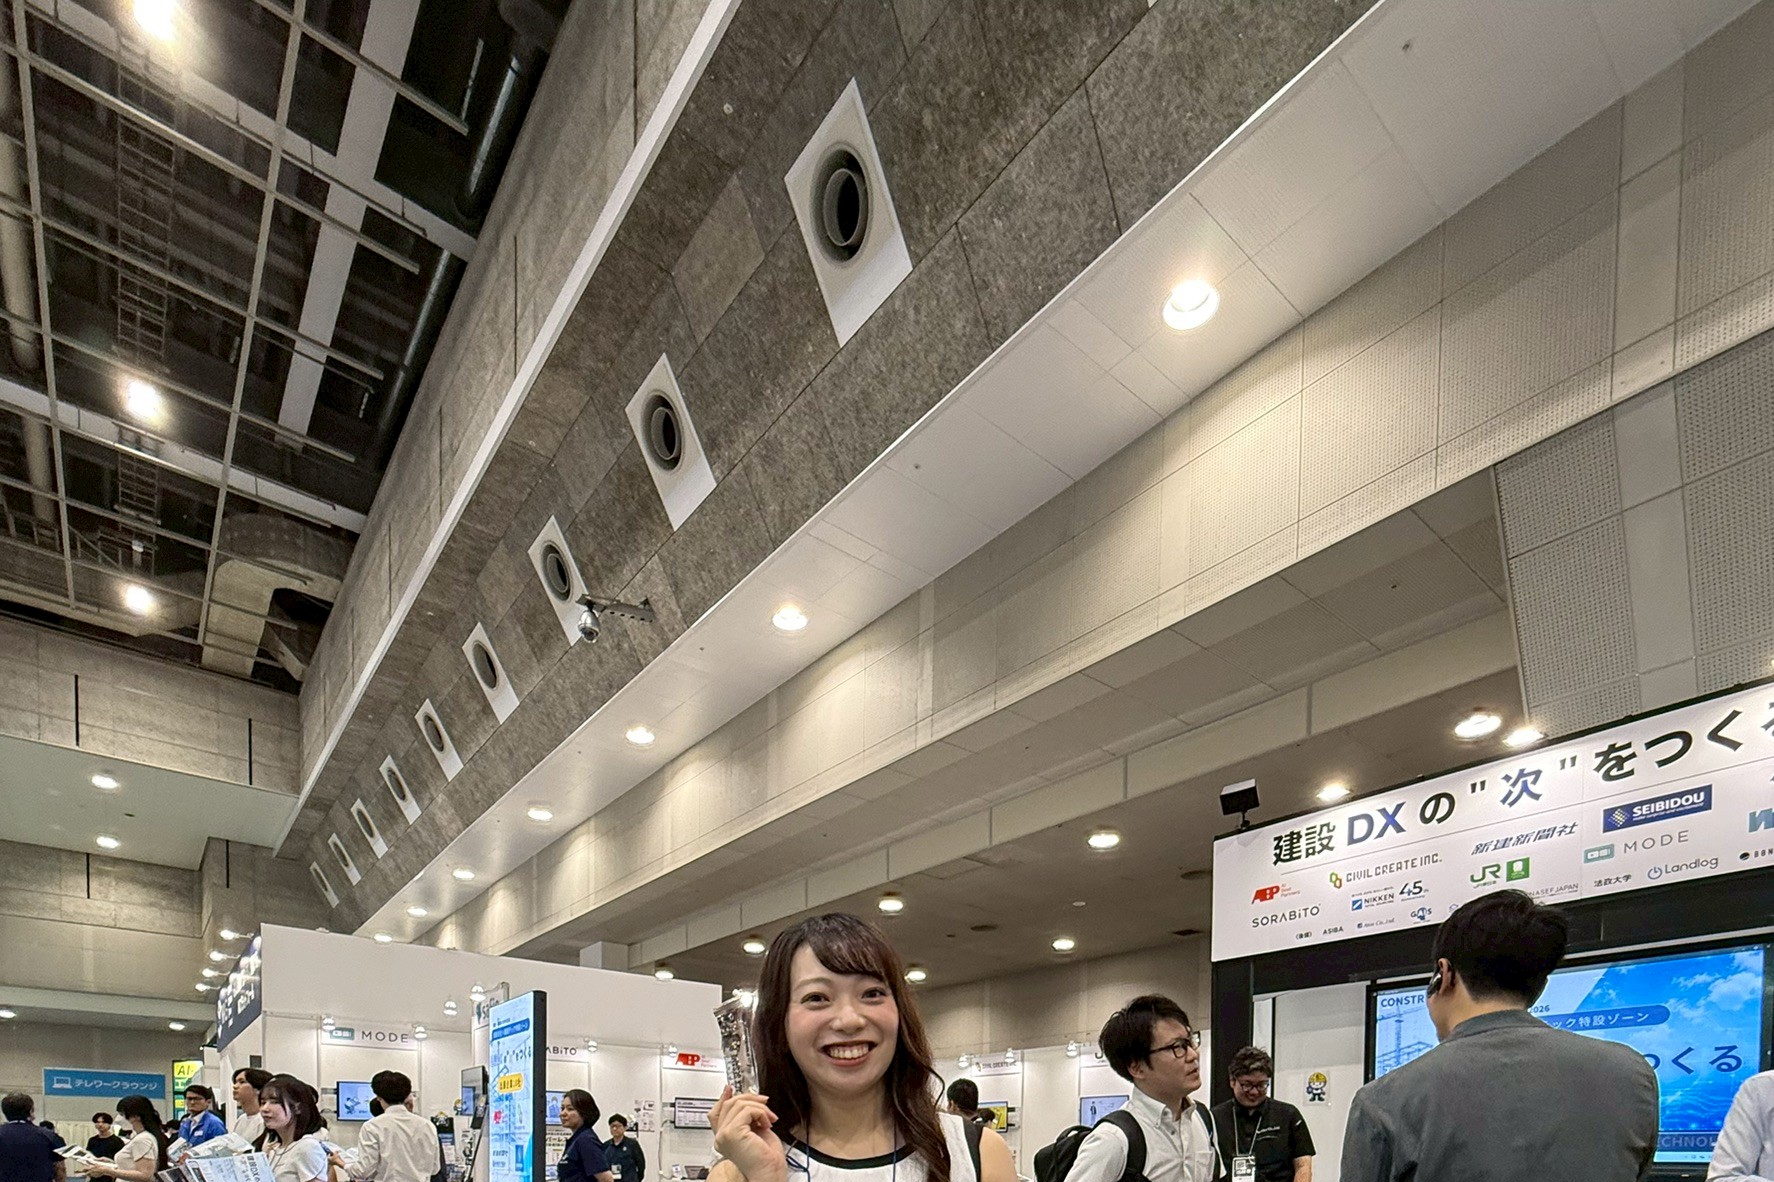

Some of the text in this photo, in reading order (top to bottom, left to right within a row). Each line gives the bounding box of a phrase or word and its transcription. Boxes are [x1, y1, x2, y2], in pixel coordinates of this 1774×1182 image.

[1632, 792, 1705, 817] SEIBIDOU
[1624, 830, 1690, 853] MODE
[1346, 869, 1373, 882] CIVIL
[1375, 857, 1418, 876] CREATE
[1470, 863, 1501, 883] JR
[1665, 857, 1719, 874] Landlog
[1555, 883, 1579, 893] JAPAN
[1364, 893, 1394, 904] NIKKEN
[361, 1030, 409, 1043] MODE
[74, 1079, 157, 1090] テレワークラウンジ
